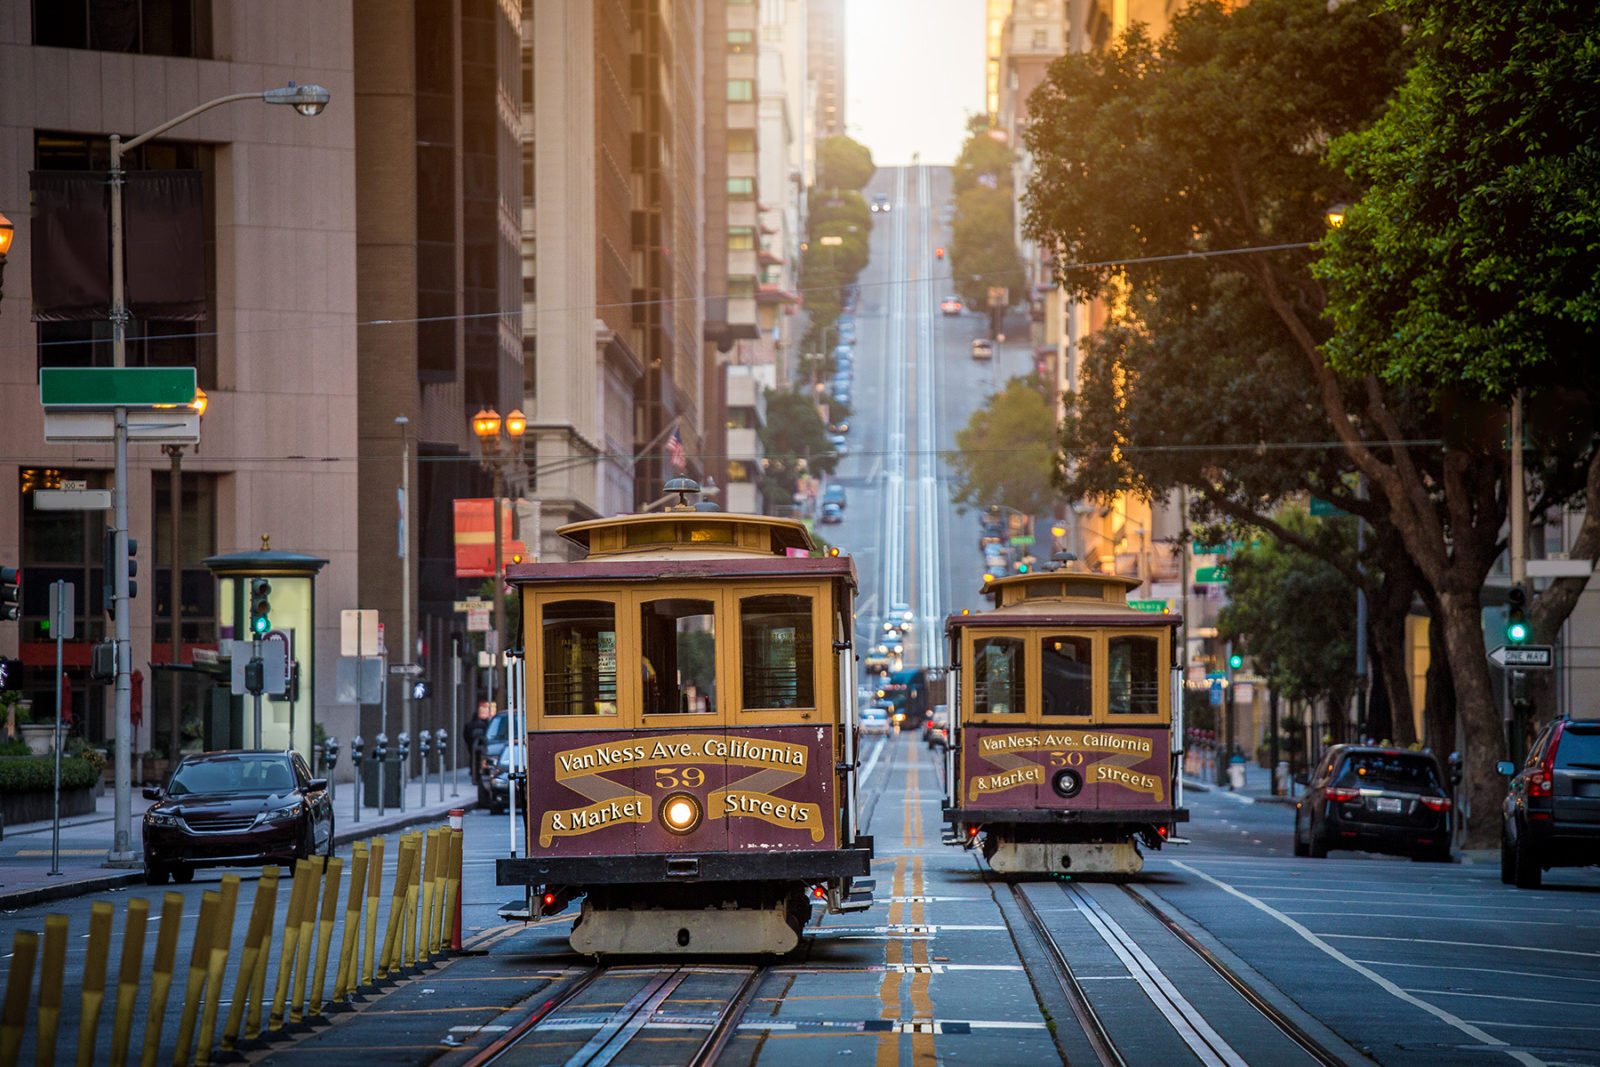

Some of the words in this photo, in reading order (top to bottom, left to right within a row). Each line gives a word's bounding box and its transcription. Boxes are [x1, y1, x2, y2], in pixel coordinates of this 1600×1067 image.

[460, 603, 487, 611] FRONT
[1505, 651, 1522, 660] ONE
[1526, 650, 1545, 661] WAY
[983, 737, 1007, 752] Van
[1008, 735, 1041, 749] Ness
[1083, 735, 1149, 752] California
[560, 754, 594, 772] Van
[597, 744, 645, 765] Ness
[703, 739, 806, 766] California
[1050, 752, 1083, 766] 50
[654, 767, 705, 789] 59
[978, 777, 987, 790] &
[992, 769, 1040, 788] Market
[1098, 767, 1153, 788] Streets
[552, 812, 568, 831] &
[571, 800, 642, 829] Market
[726, 794, 810, 822] Streets
